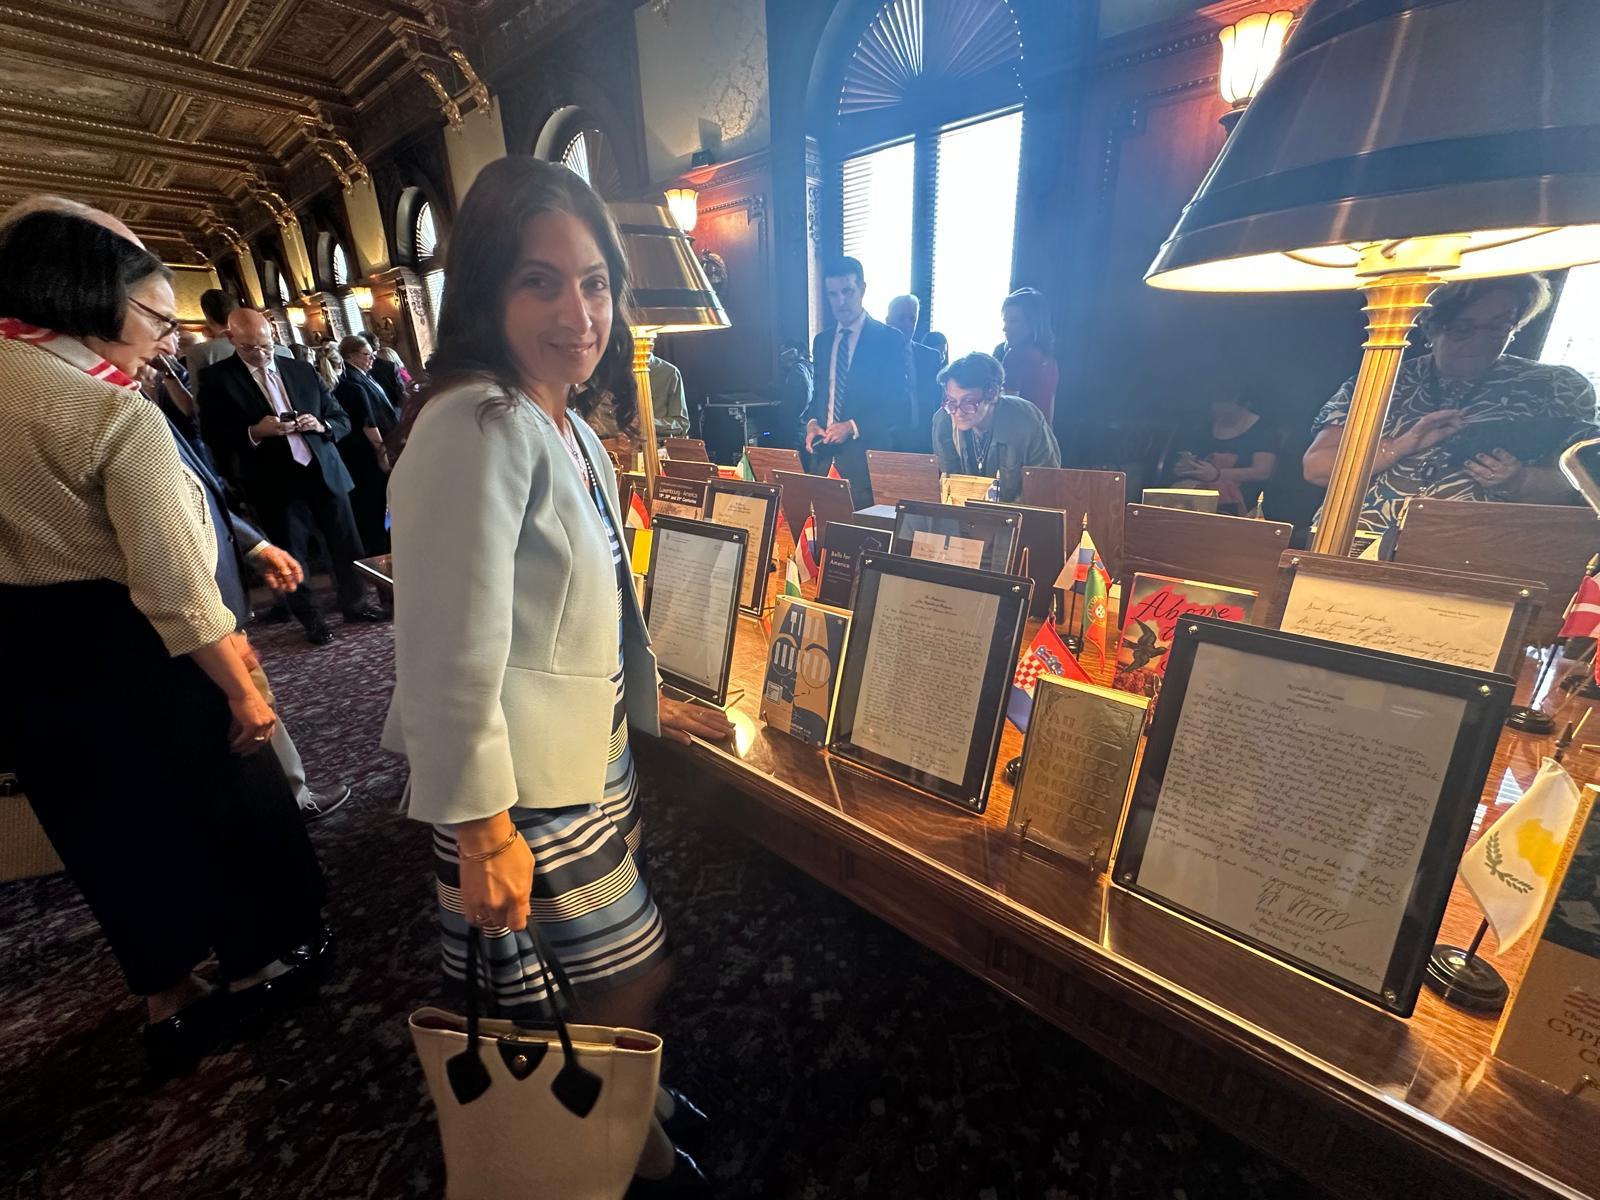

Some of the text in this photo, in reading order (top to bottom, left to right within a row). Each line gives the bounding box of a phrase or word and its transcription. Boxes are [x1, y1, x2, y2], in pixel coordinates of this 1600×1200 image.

[830, 559, 851, 569] America
[1130, 591, 1231, 621] Above
[1248, 922, 1284, 947] Republic
[1259, 913, 1311, 944] Ambassador
[1331, 942, 1346, 956] the
[1579, 1049, 1600, 1067] C
